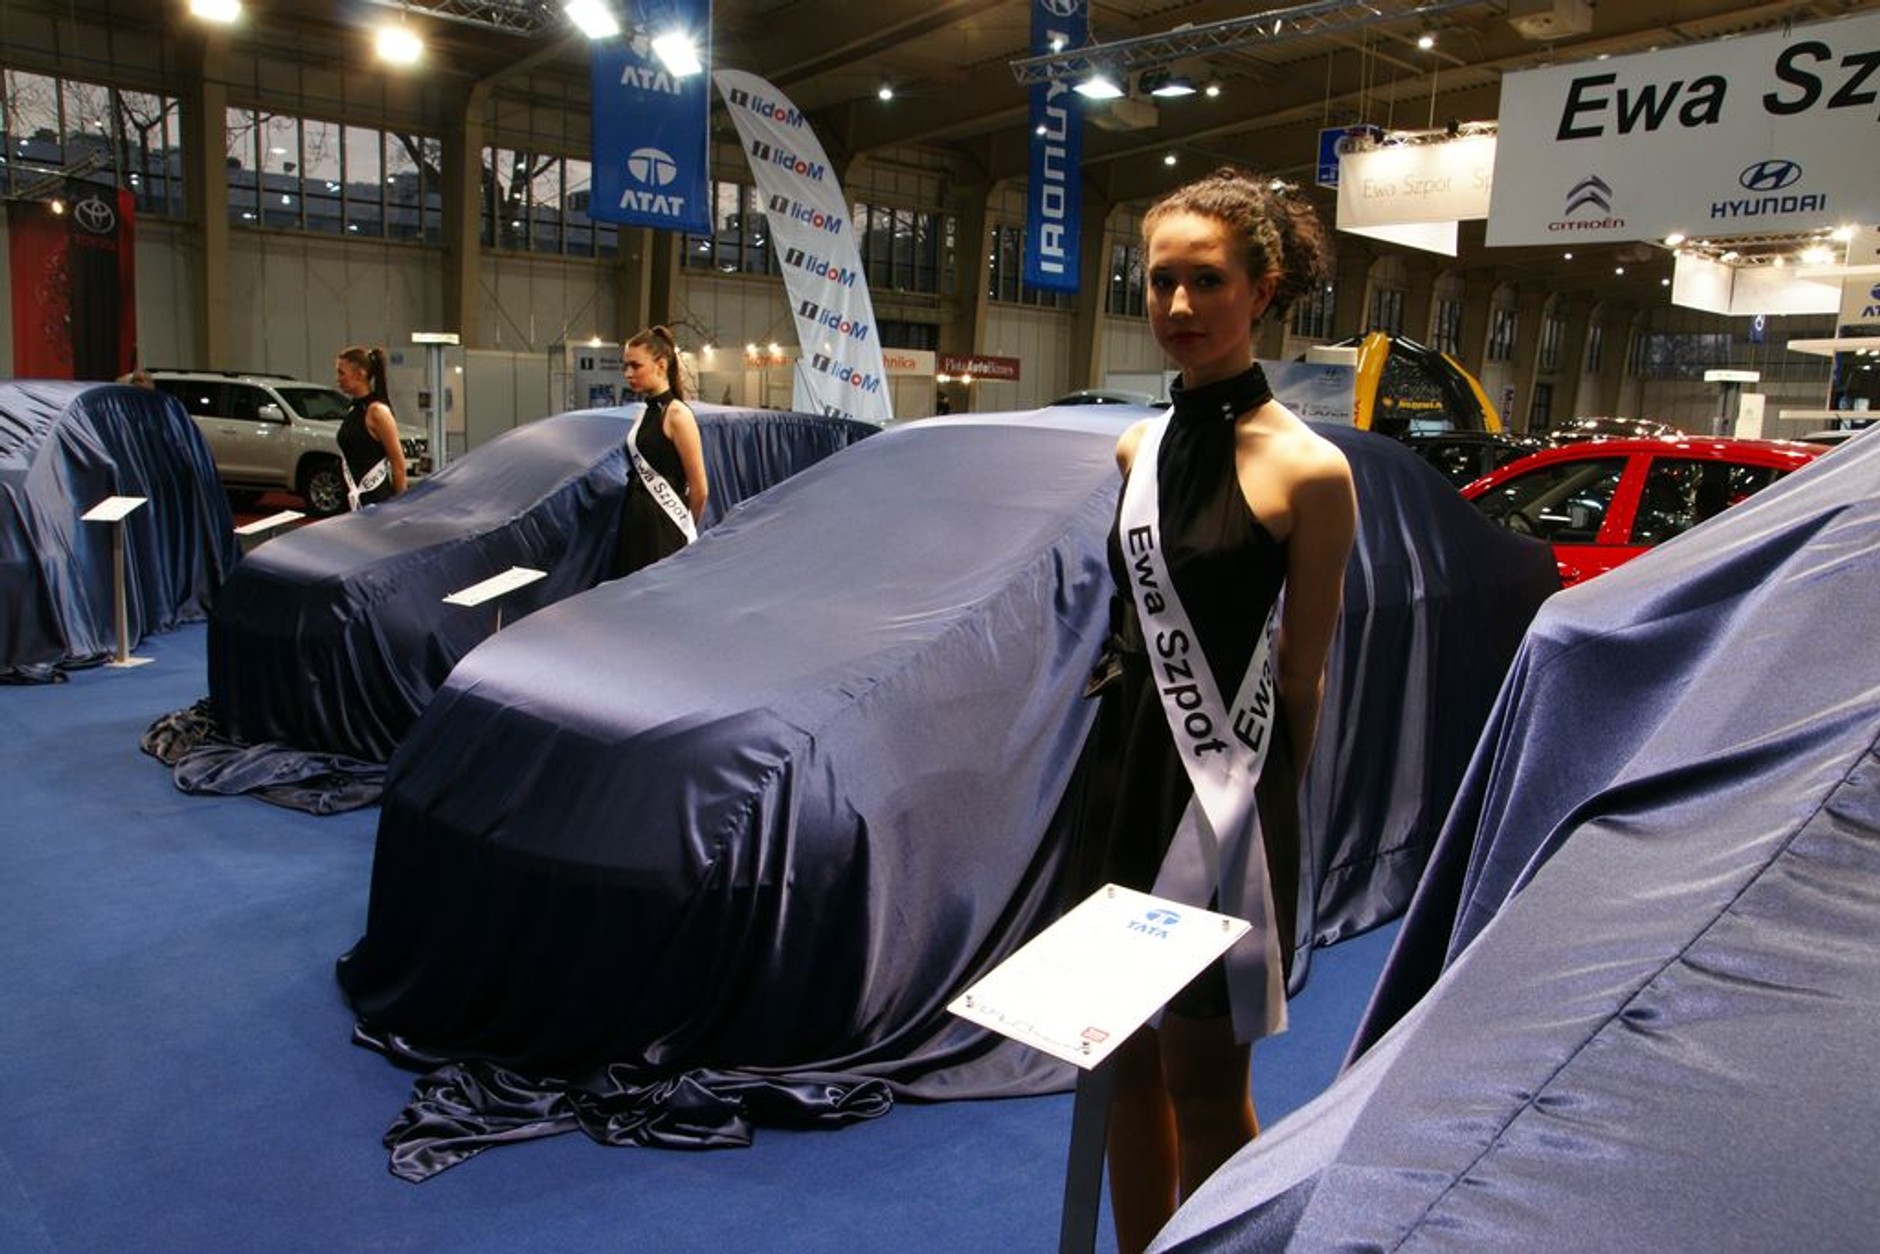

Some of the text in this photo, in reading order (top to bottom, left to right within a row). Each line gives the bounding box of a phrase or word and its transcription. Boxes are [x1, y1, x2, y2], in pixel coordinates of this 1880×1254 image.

[1556, 40, 1880, 141] Ewa Sz
[1710, 194, 1826, 220] HYUNDAI
[1547, 217, 1626, 233] CITROËN
[1128, 525, 1229, 757] Ewa Szpot
[1126, 919, 1169, 940] TATA
